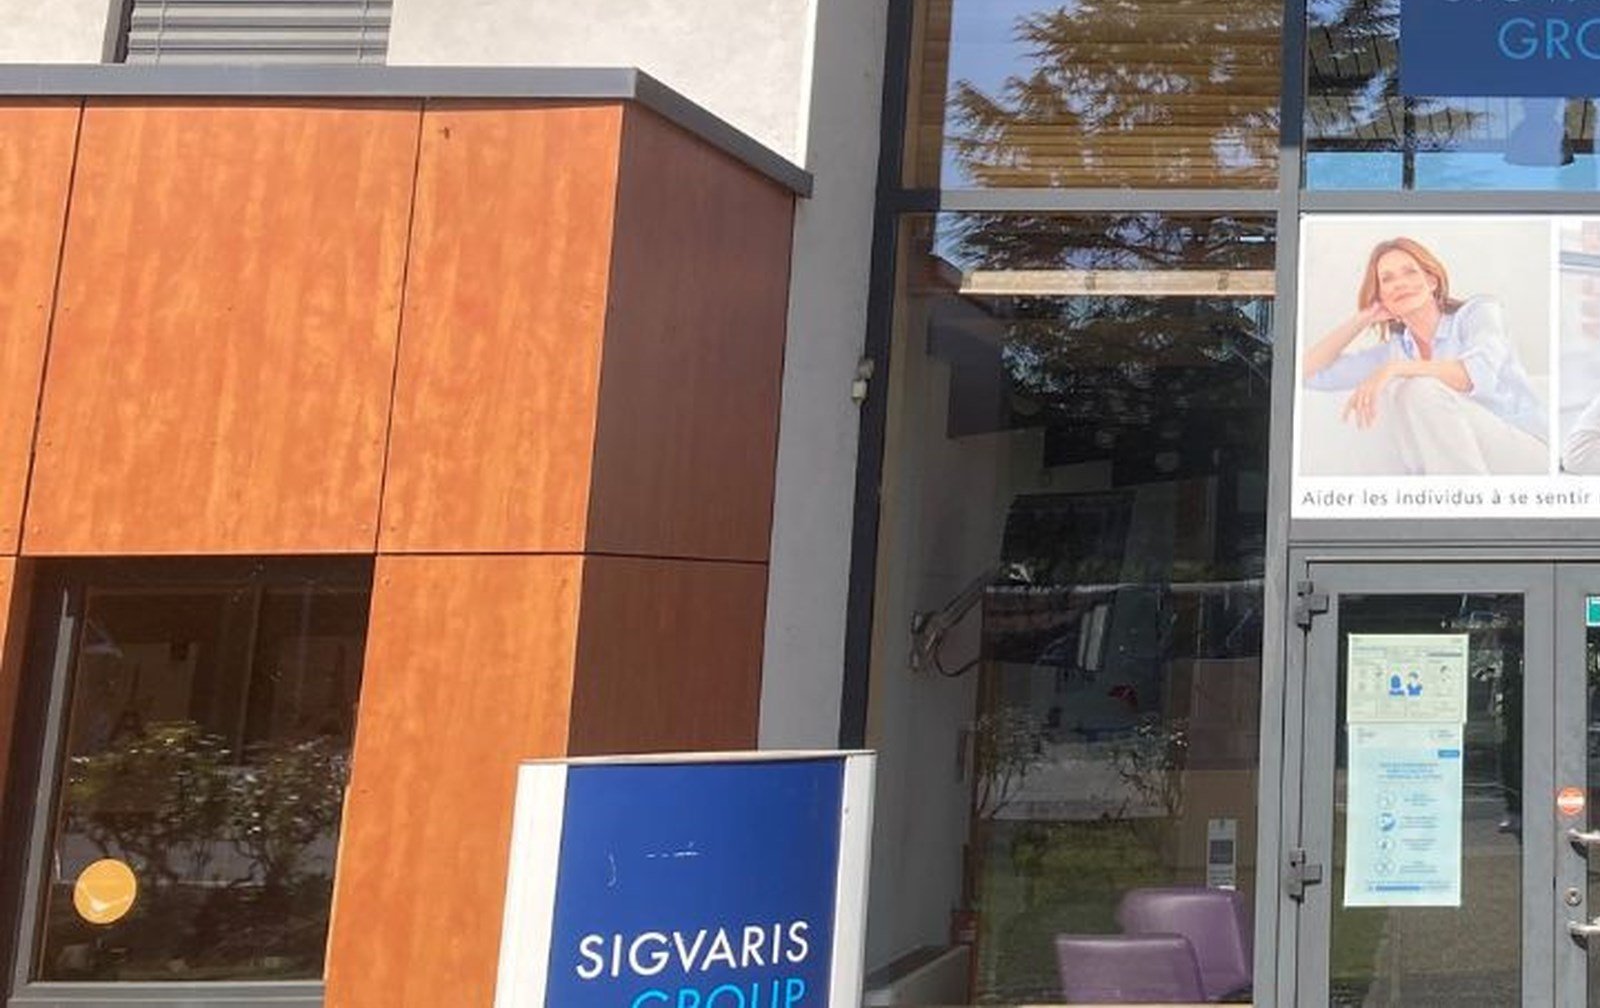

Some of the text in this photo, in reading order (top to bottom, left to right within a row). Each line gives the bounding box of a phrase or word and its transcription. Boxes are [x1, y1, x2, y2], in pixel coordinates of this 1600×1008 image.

[1301, 489, 1355, 506] Aider
[1363, 489, 1388, 506] les
[1491, 489, 1501, 506] à
[1508, 493, 1529, 505] se
[1535, 489, 1591, 505] sentir
[576, 920, 810, 980] SIGVARIS
